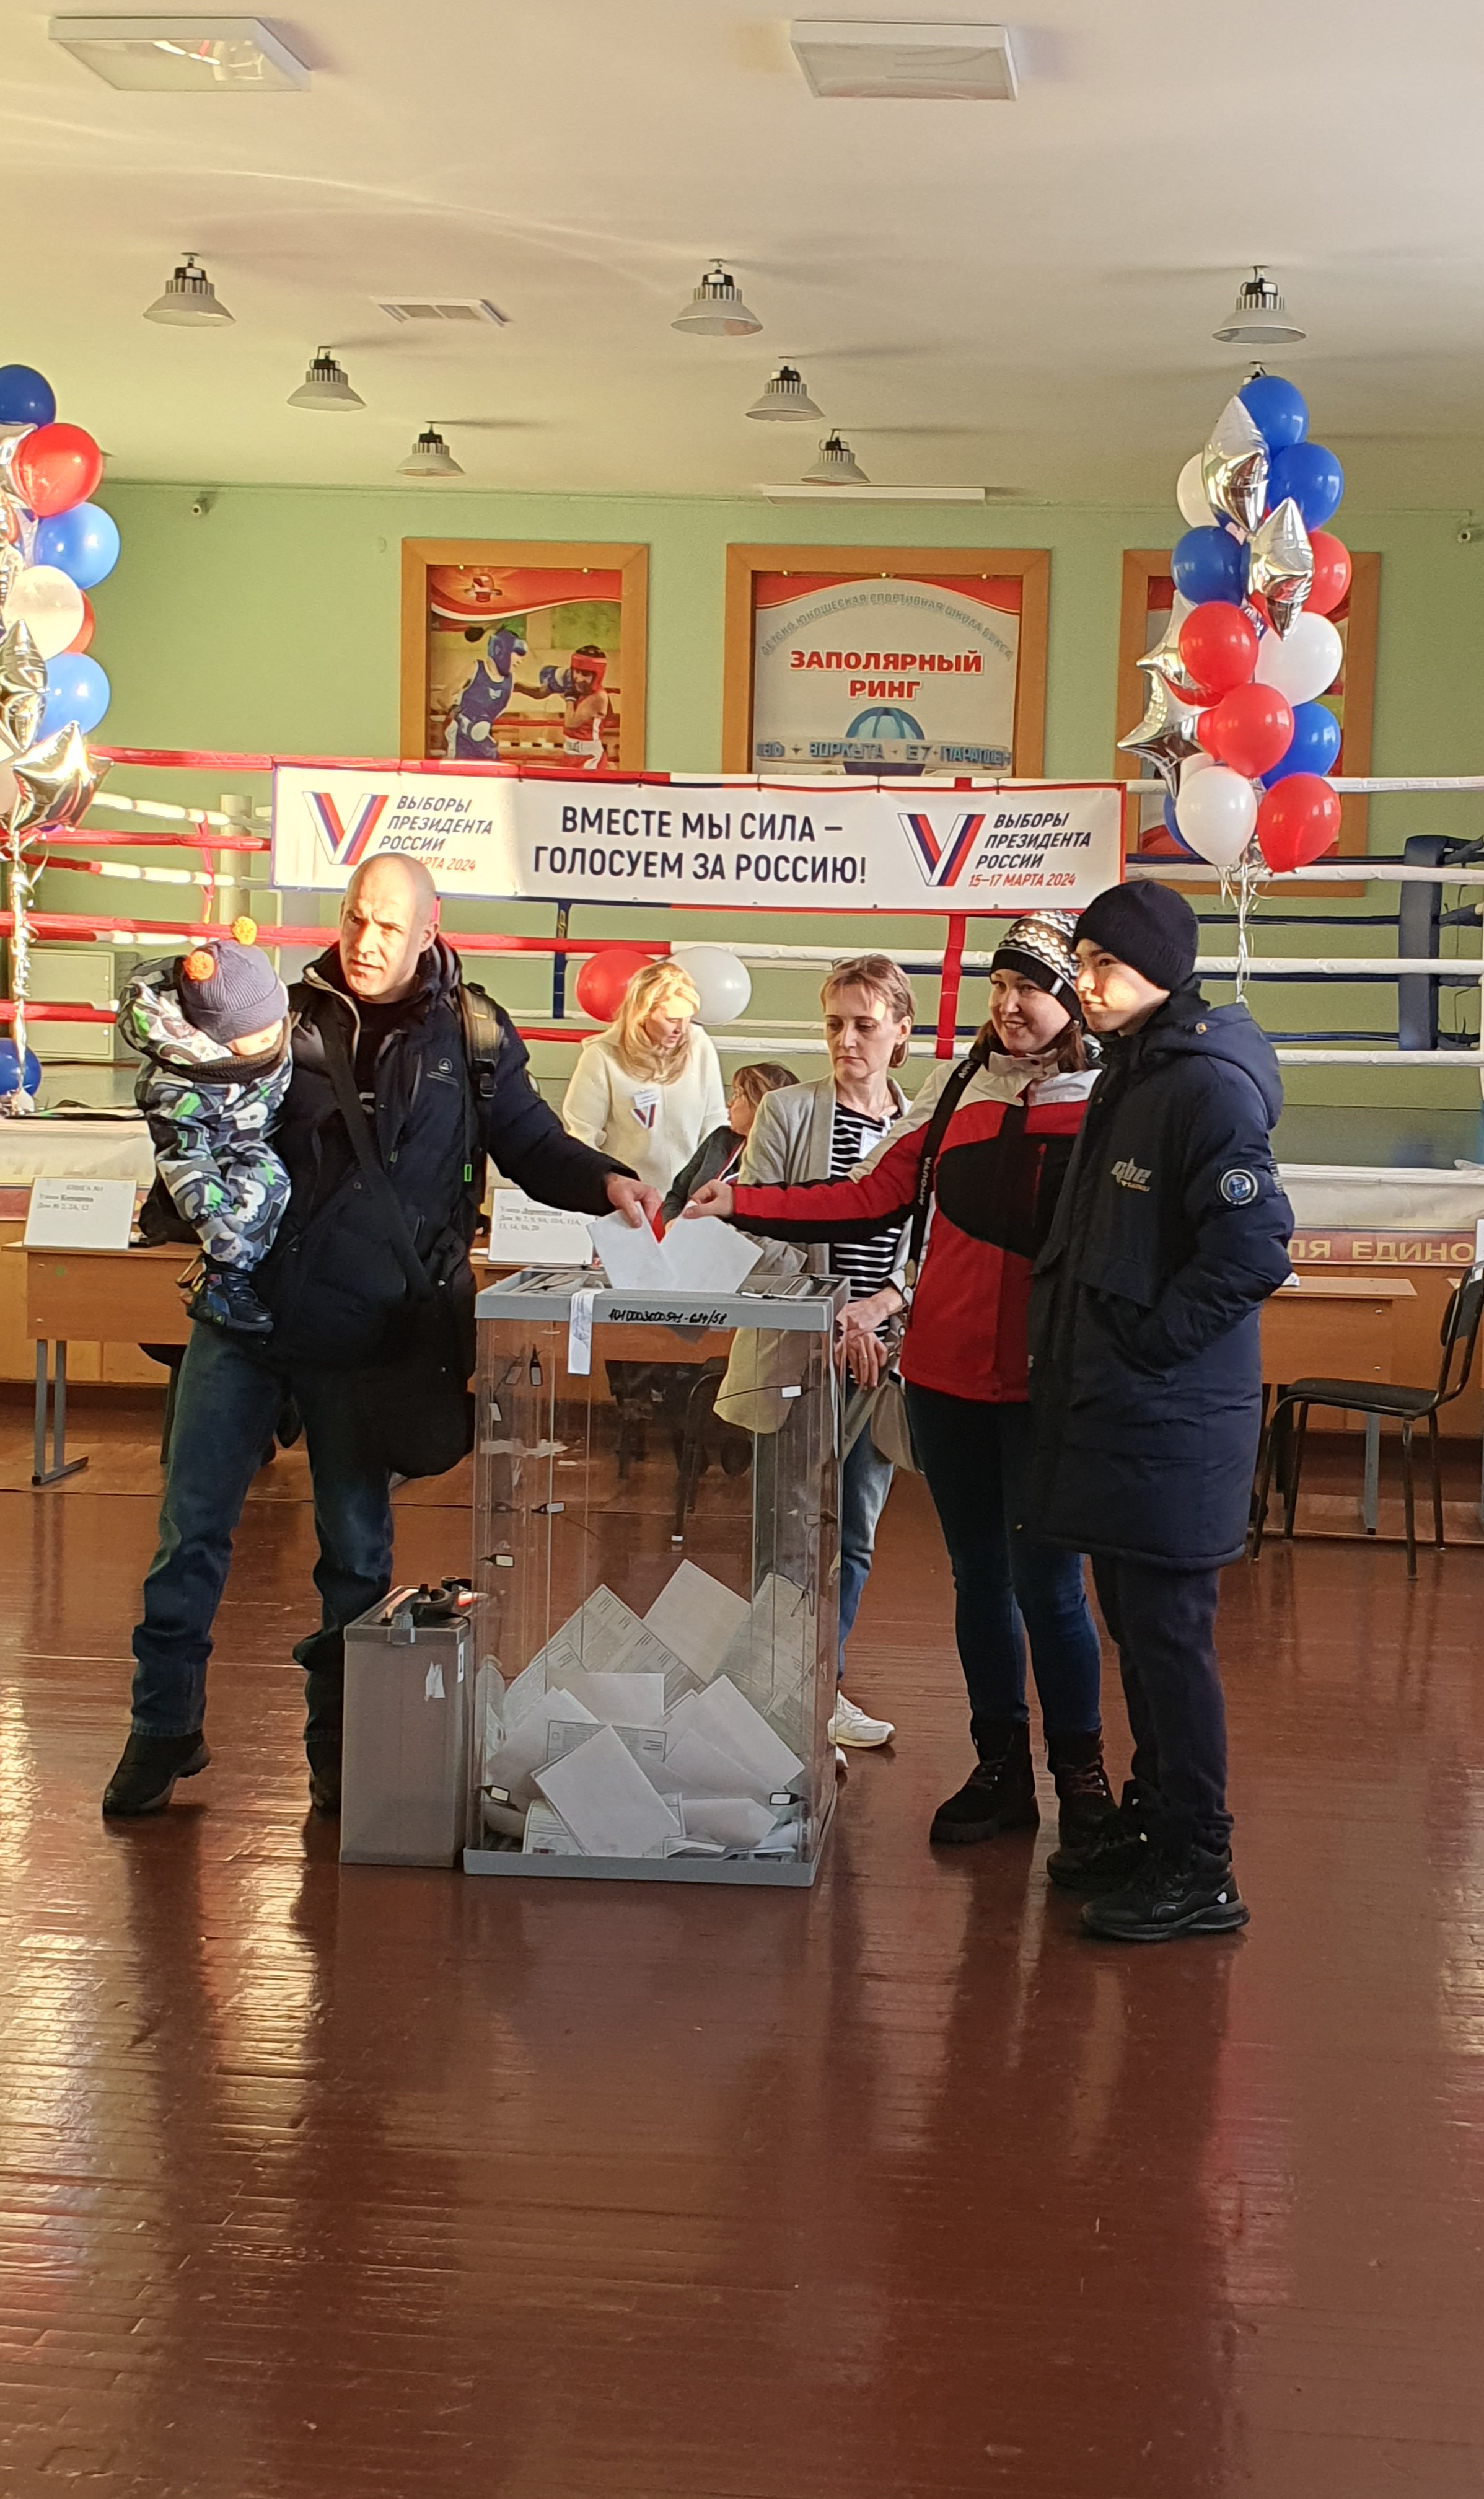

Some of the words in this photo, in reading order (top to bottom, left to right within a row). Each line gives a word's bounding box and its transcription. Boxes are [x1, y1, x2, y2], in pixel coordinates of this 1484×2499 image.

[944, 605, 982, 632] ШКОЛА
[790, 650, 982, 672] ЗАПОЛЯРНЫЙ
[849, 679, 921, 699] РИНГ
[396, 795, 472, 813] ВЫБОРЫ
[387, 815, 493, 834] ПРЕЗИДЕНТА
[561, 806, 672, 838] ВМЕСТЕ
[682, 812, 731, 840] МЫ
[740, 812, 815, 842] СИЛА
[993, 812, 1071, 829] ВЫБОРЫ
[378, 835, 446, 852] РОССИИ
[984, 832, 1092, 850] ПРЕЗИДЕНТА
[414, 856, 445, 870] АРТА
[446, 857, 476, 871] 2024
[533, 846, 683, 879] ГОЛОСУЕМ
[692, 853, 726, 880] ЗА
[735, 853, 866, 884] РОССИЮ!
[975, 853, 1045, 870] РОССИИ
[1003, 873, 1045, 887] МАРТА
[1045, 873, 1076, 887] 2024
[1352, 1241, 1474, 1262] ЕДИНО
